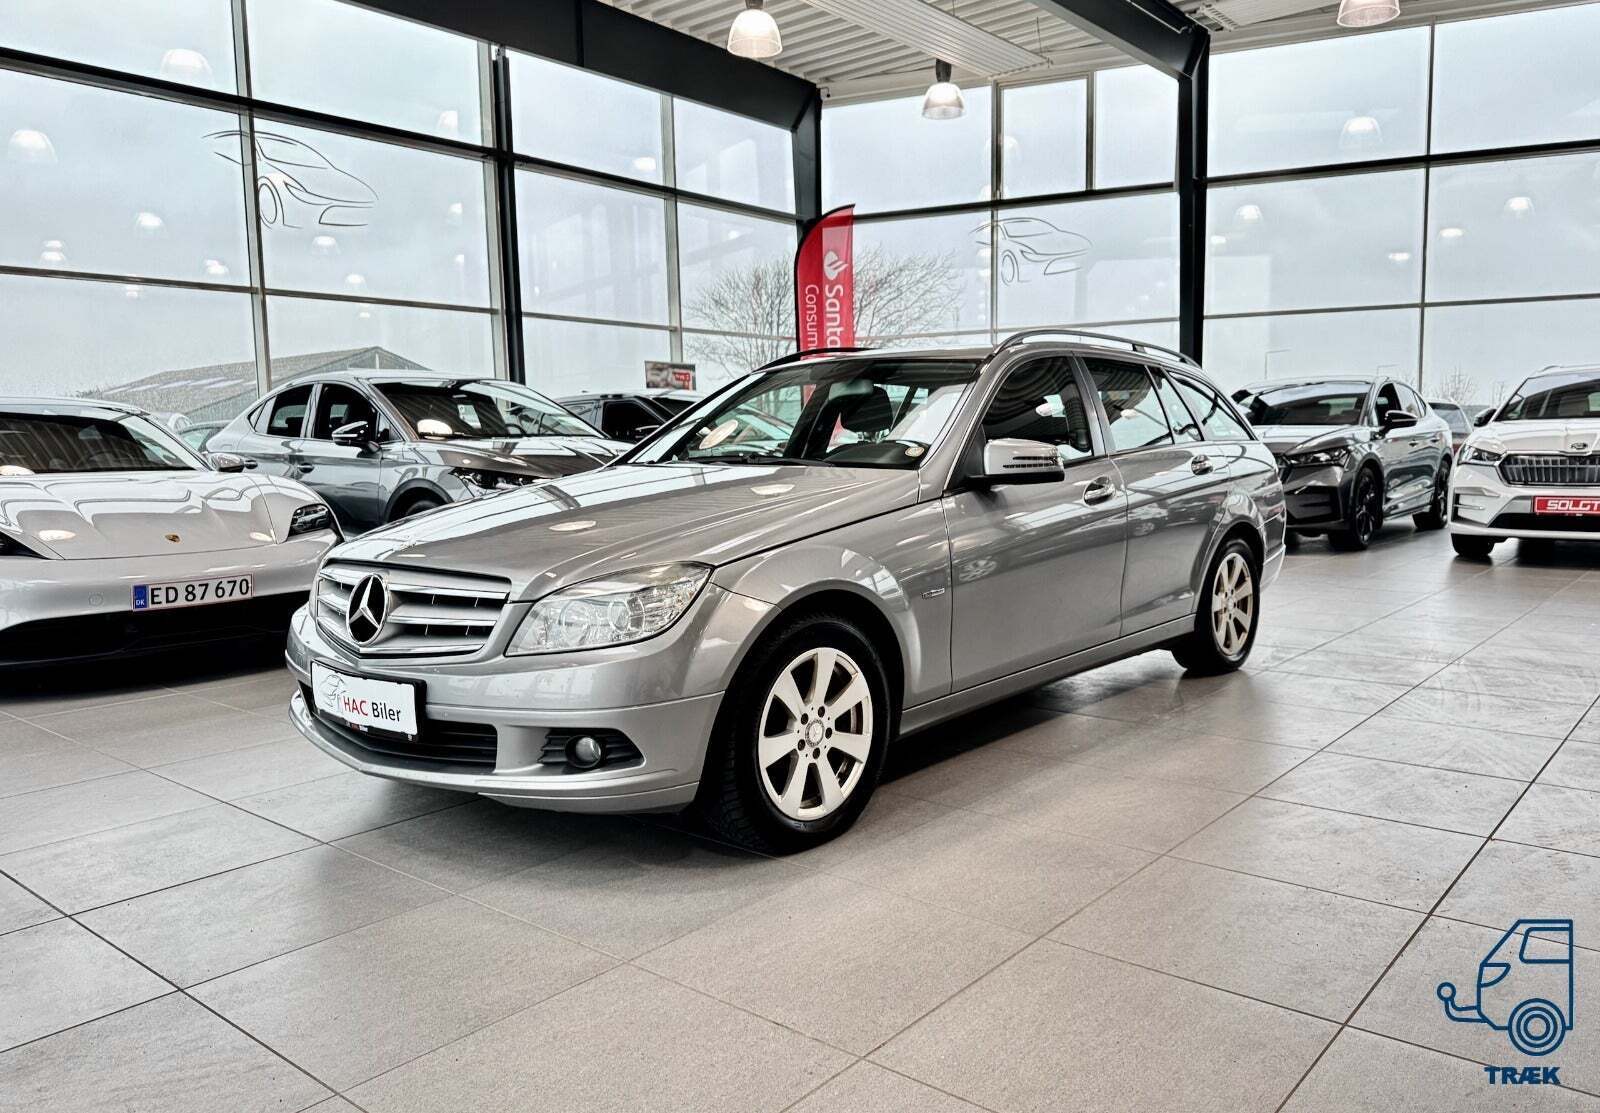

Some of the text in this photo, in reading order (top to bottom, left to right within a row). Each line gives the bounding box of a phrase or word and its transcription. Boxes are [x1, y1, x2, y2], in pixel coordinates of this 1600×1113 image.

[805, 284, 820, 350] Consum
[824, 284, 844, 348] Santa
[150, 578, 250, 605] ED 87 670
[343, 696, 401, 722] HAC Biler
